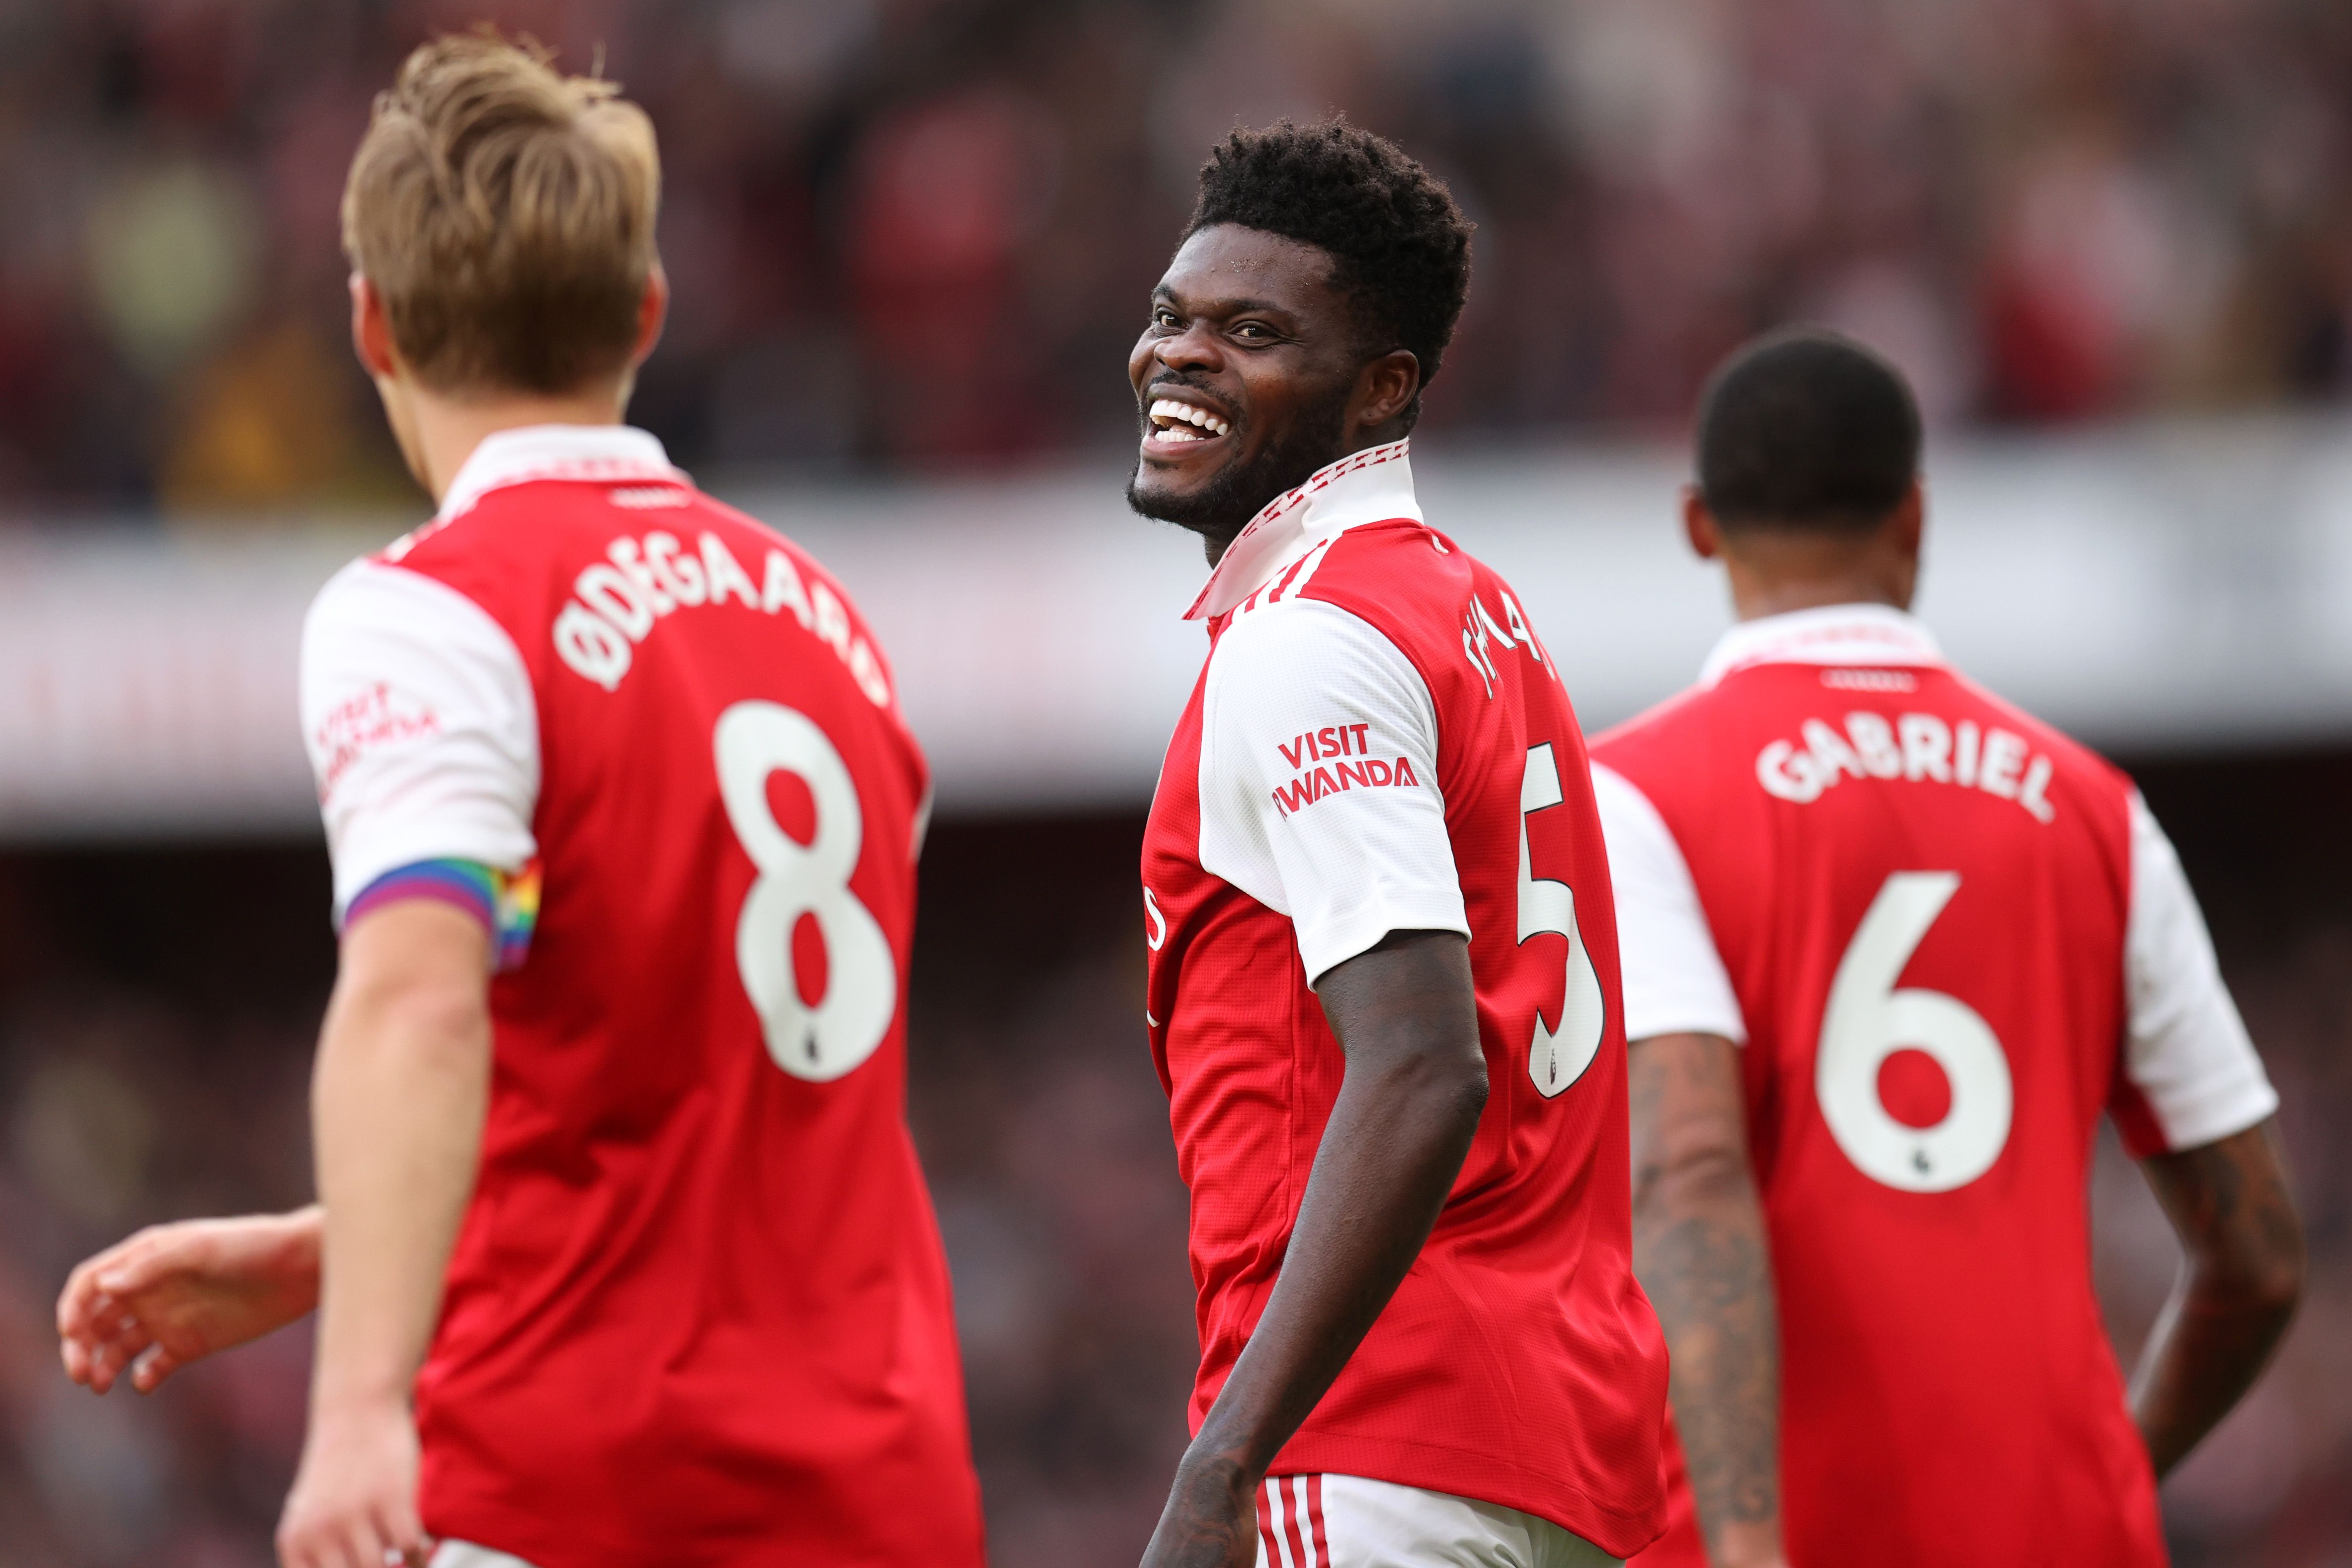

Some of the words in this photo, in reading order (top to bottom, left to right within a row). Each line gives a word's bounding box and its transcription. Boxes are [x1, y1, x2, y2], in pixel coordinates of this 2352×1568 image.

[713, 698, 897, 1083] 8
[1278, 723, 1369, 769] VISIT
[1755, 710, 2056, 826] GABRIEL
[1516, 741, 1605, 1100] 5
[1813, 869, 2015, 1194] 6
